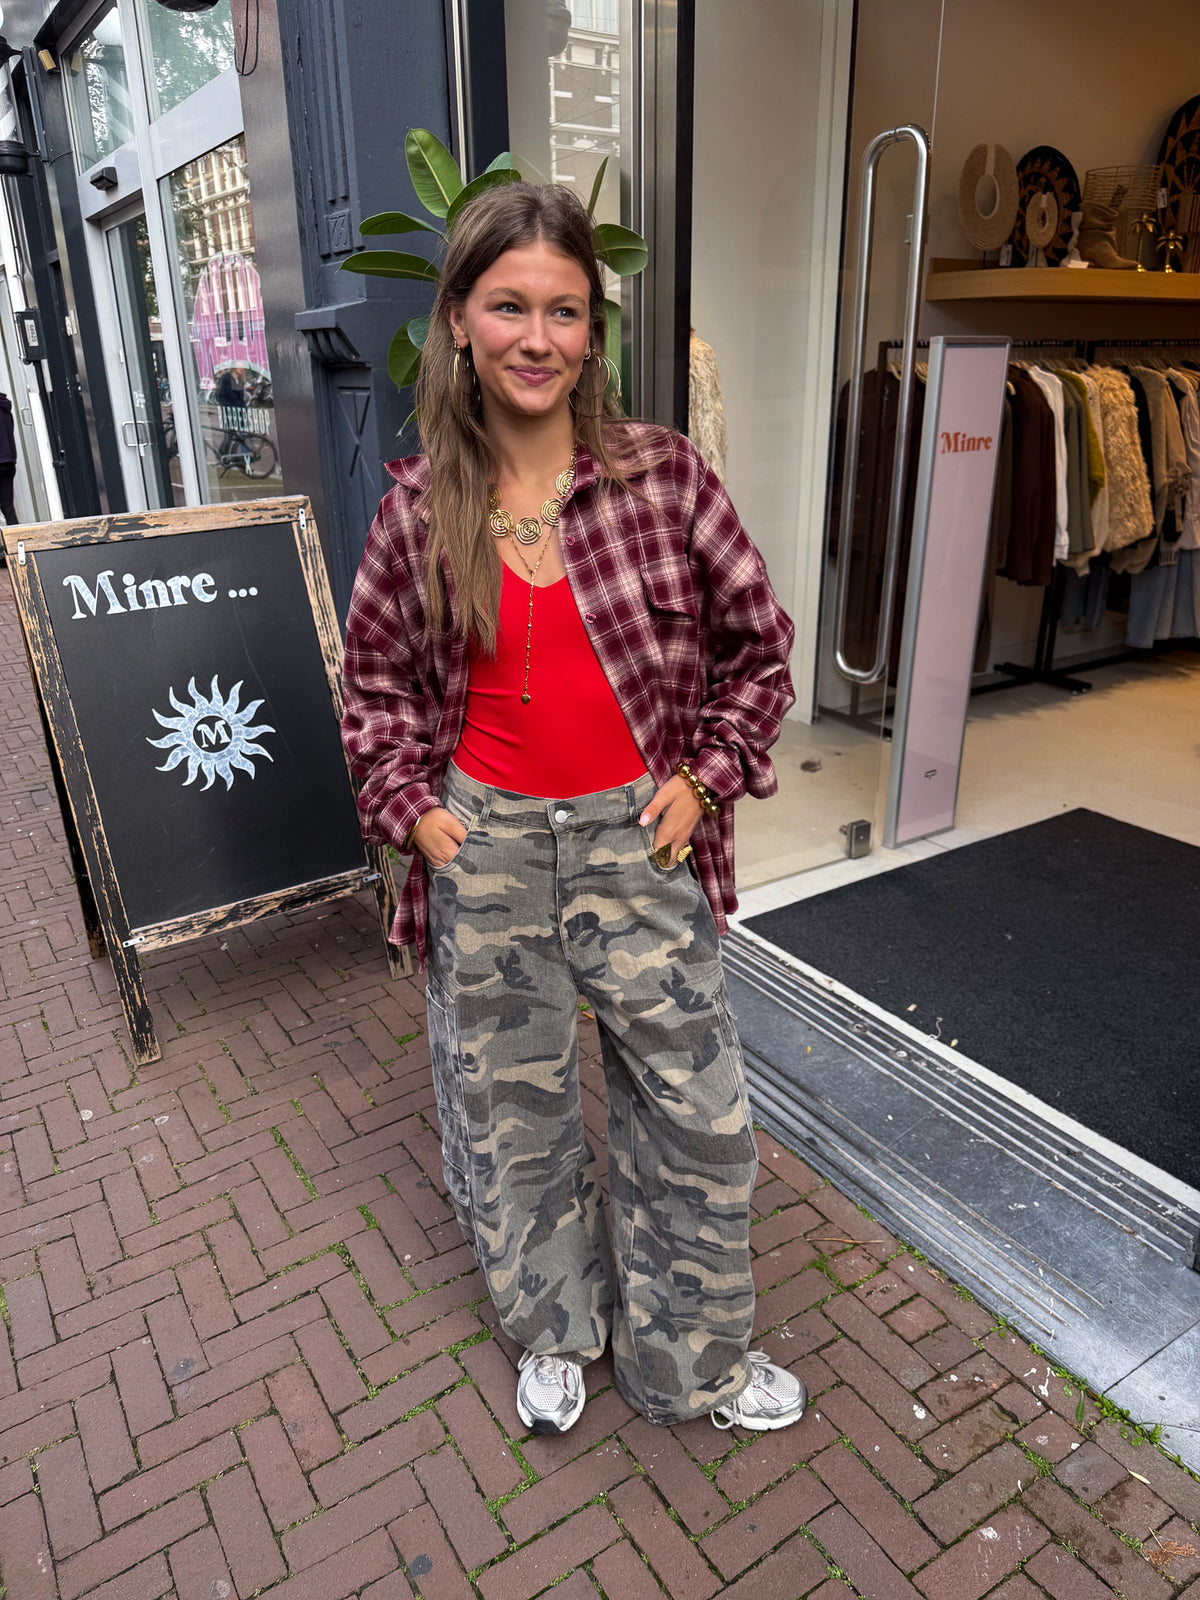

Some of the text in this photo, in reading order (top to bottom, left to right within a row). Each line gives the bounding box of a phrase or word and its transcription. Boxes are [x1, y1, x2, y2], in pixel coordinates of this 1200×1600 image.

[941, 432, 992, 454] Minre
[62, 570, 217, 619] Minre
[197, 720, 231, 748] M
